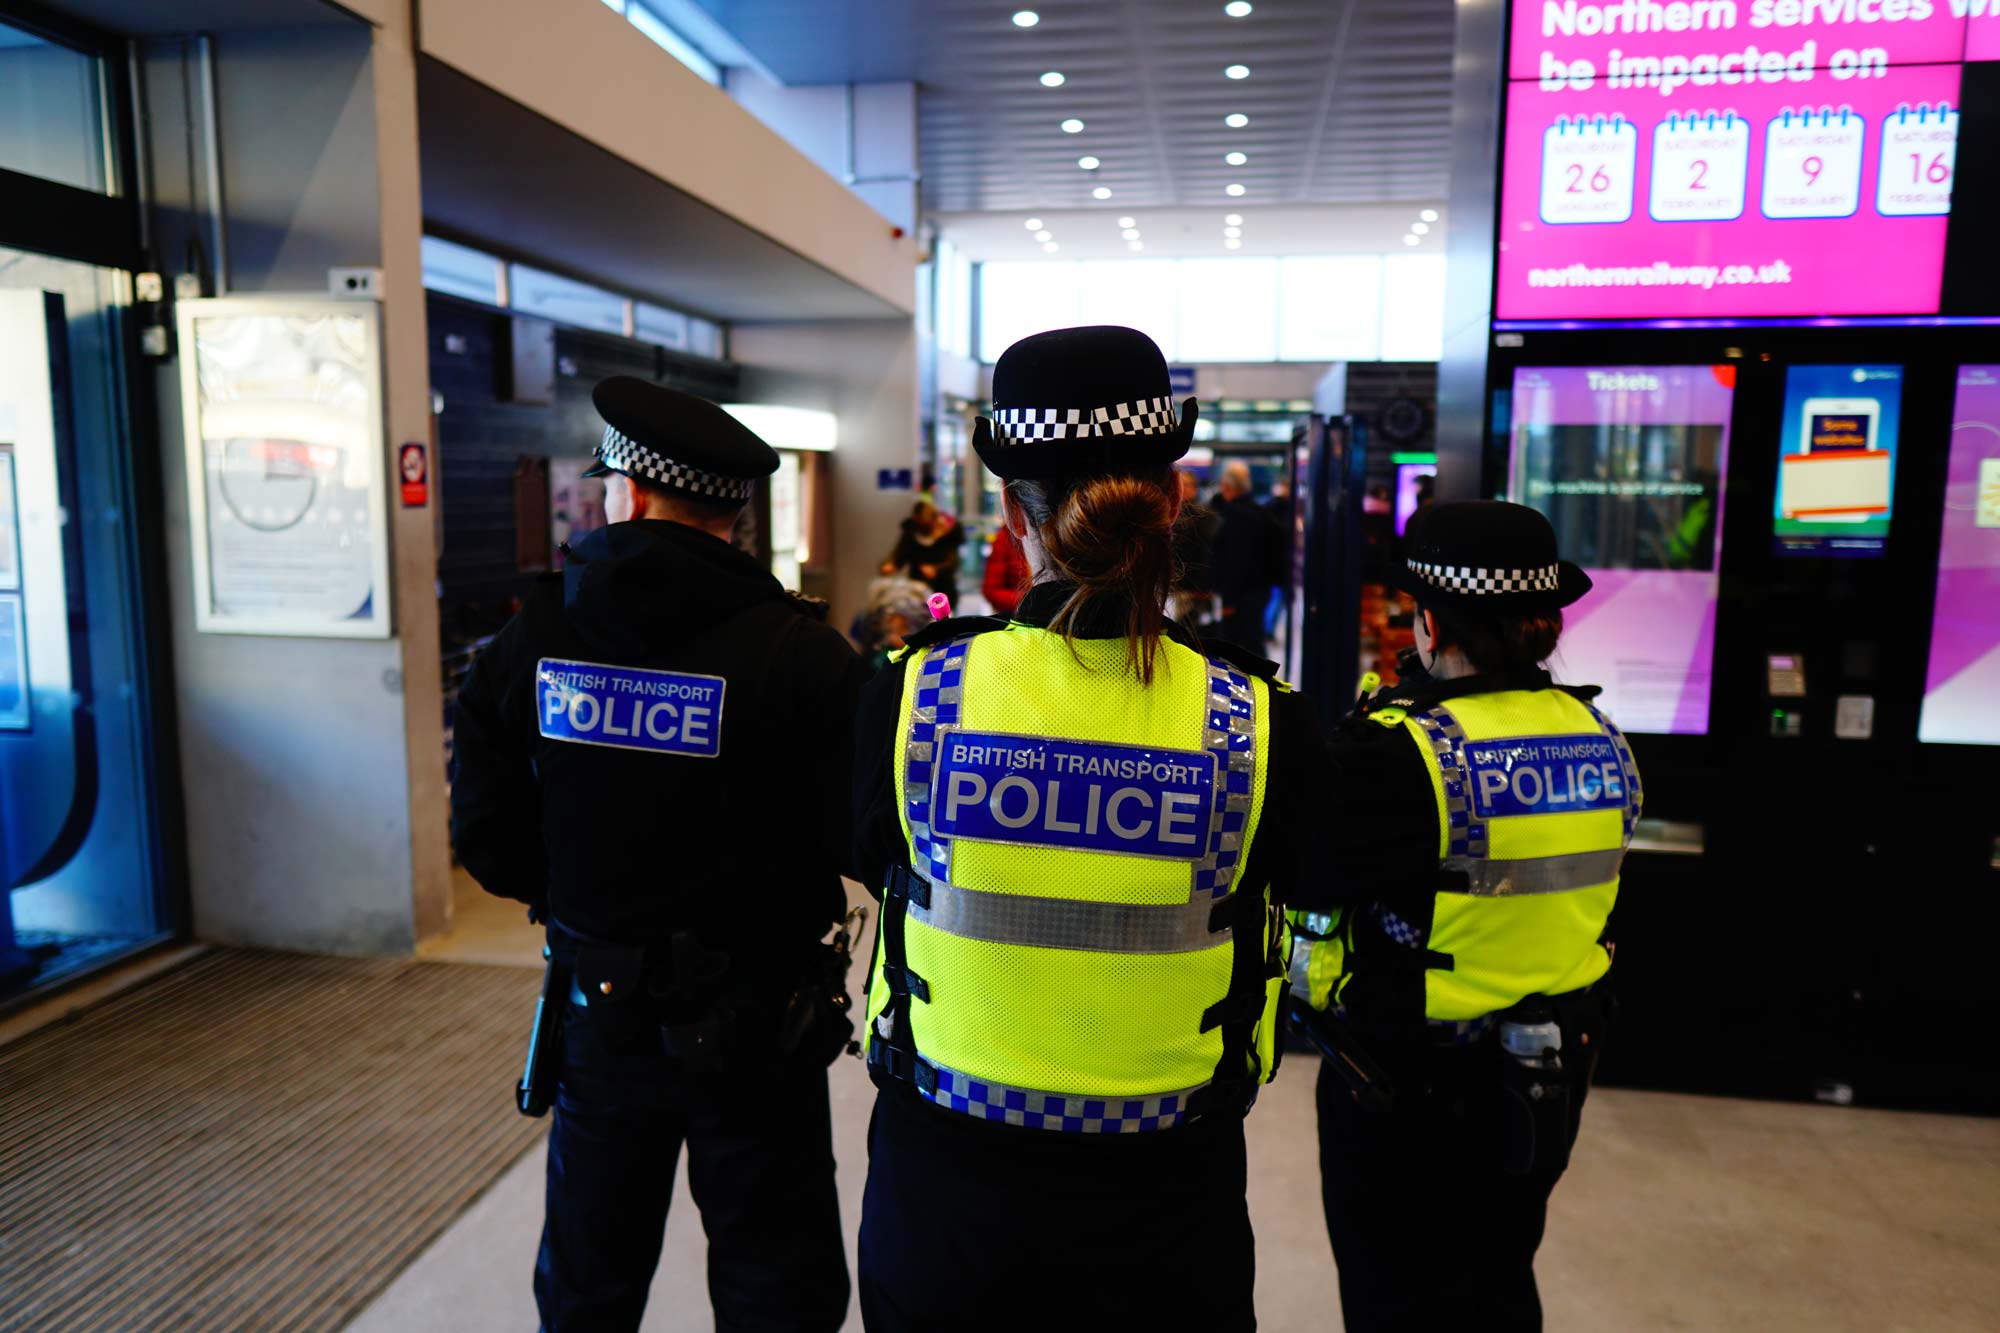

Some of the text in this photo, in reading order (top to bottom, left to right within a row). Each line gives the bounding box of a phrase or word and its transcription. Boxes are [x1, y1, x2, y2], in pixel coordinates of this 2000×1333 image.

[1542, 0, 1737, 37] Northern
[1749, 0, 1934, 27] services
[1539, 40, 1888, 96] be impacted on
[1565, 163, 1611, 193] 26
[1688, 159, 1709, 190] 2
[1802, 155, 1823, 187] 9
[1910, 151, 1951, 184] 16
[1528, 260, 1792, 290] northernrailway.co.uk
[1587, 371, 1659, 391] Tickets
[546, 669, 714, 702] BRITISH TRANSPORT
[544, 689, 711, 745] POLICE
[952, 744, 1203, 785] BRITISH TRANSPORT
[1473, 744, 1612, 765] BRITISH TRANSPORT
[1478, 763, 1623, 808] POLICE
[945, 771, 1201, 845] POLICE
